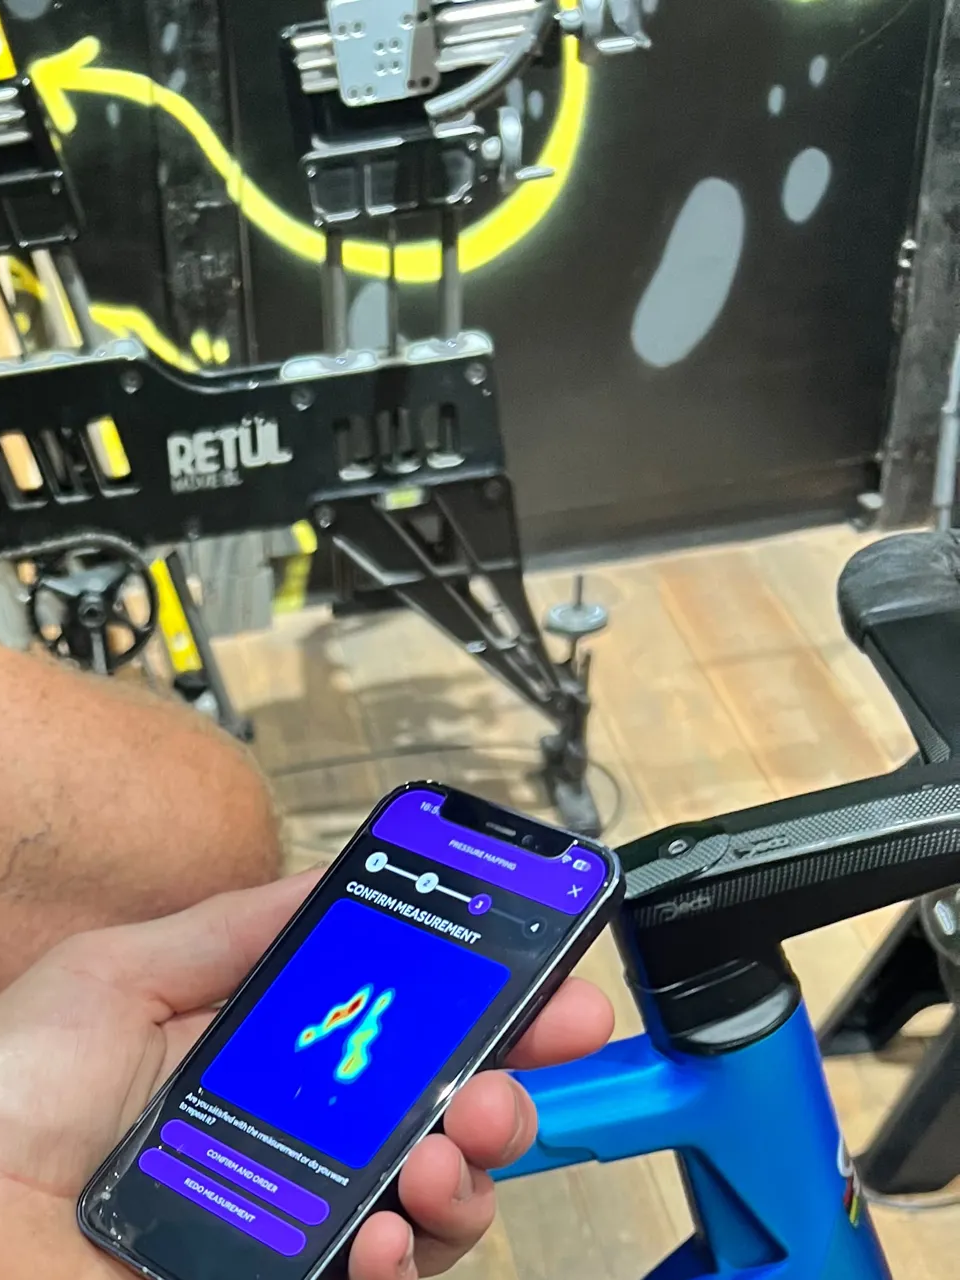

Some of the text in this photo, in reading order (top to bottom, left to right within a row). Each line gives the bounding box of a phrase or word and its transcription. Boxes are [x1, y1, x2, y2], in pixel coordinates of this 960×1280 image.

[167, 416, 293, 477] RETÜL
[448, 838, 516, 872] PRESSURE MAPPING
[345, 881, 481, 945] CONFIRM MEASUREMENT
[530, 922, 540, 933] 4
[178, 1101, 188, 1111] to
[185, 1105, 206, 1122] repeat
[185, 1092, 198, 1103] Are
[197, 1097, 209, 1110] you
[233, 1116, 248, 1132] with
[247, 1123, 258, 1137] the
[308, 1159, 319, 1169] do
[315, 1165, 331, 1177] you
[330, 1170, 350, 1187] want
[206, 1149, 278, 1194] CONFIRM AND ORDER
[183, 1177, 256, 1223] REDO MEASUREMENT
